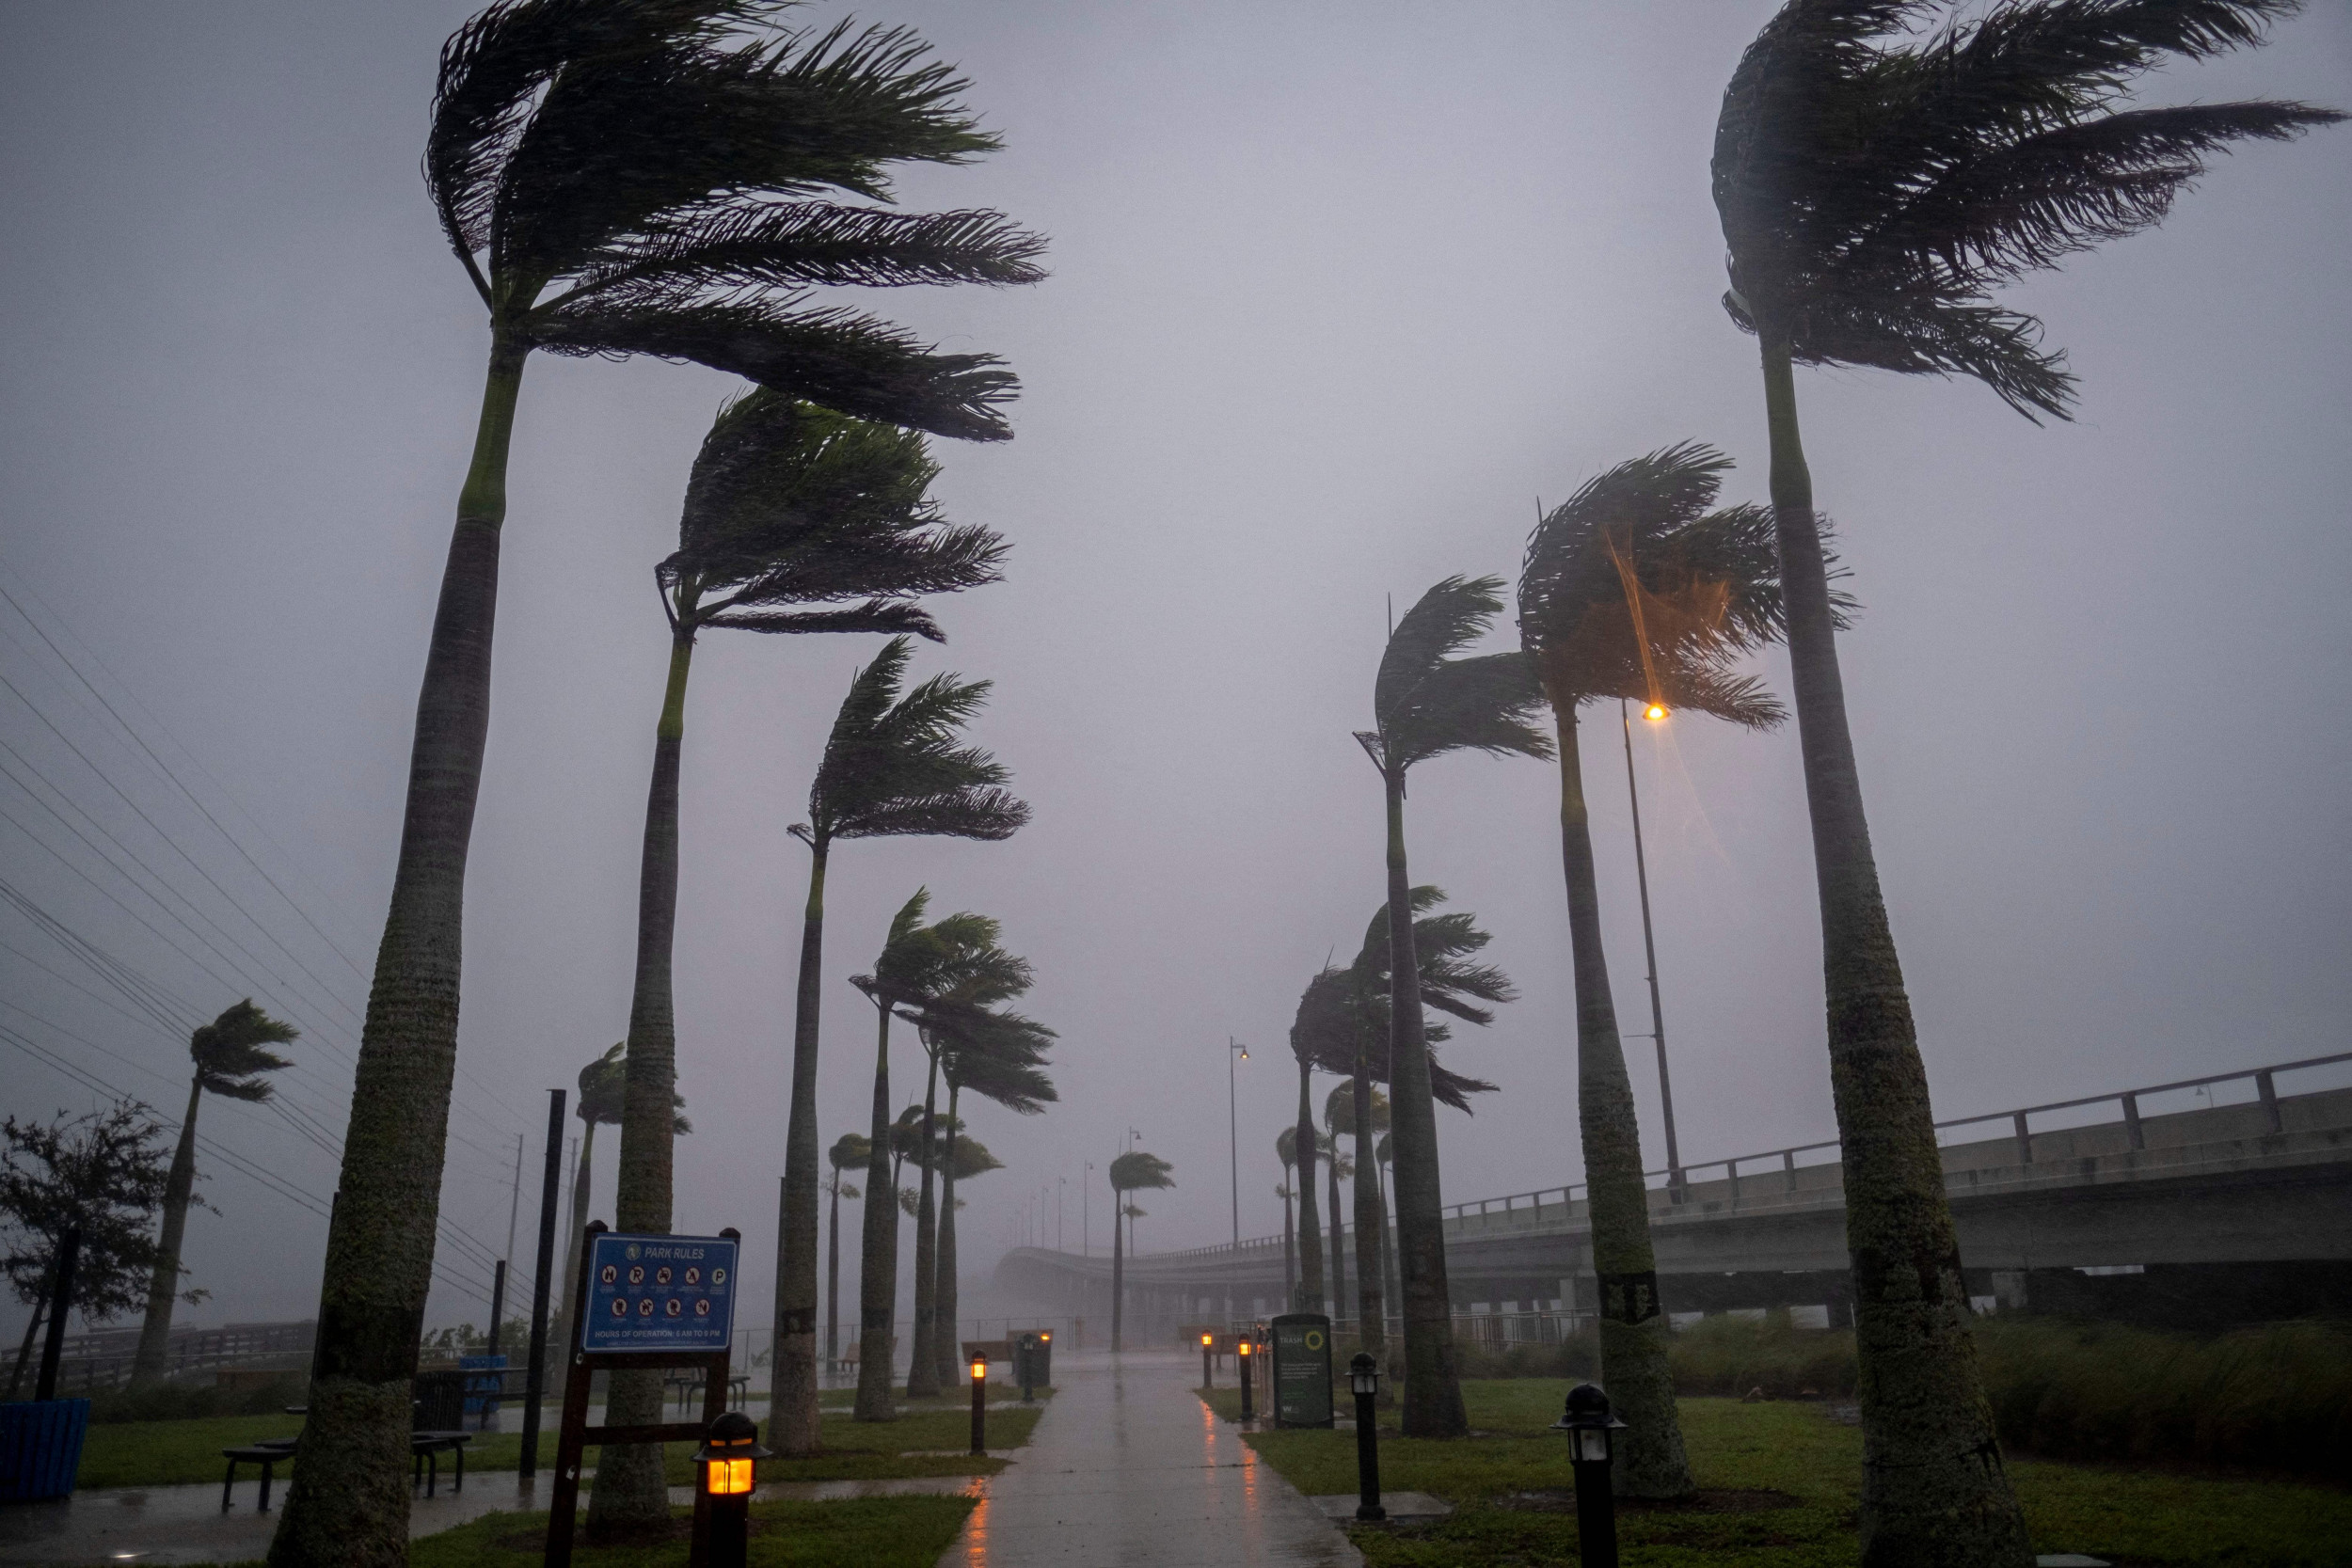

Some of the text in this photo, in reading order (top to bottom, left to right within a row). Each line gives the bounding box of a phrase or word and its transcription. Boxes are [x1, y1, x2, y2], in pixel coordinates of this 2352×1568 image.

[644, 1247, 705, 1259] PARK RULES
[595, 1330, 620, 1338] HOURS
